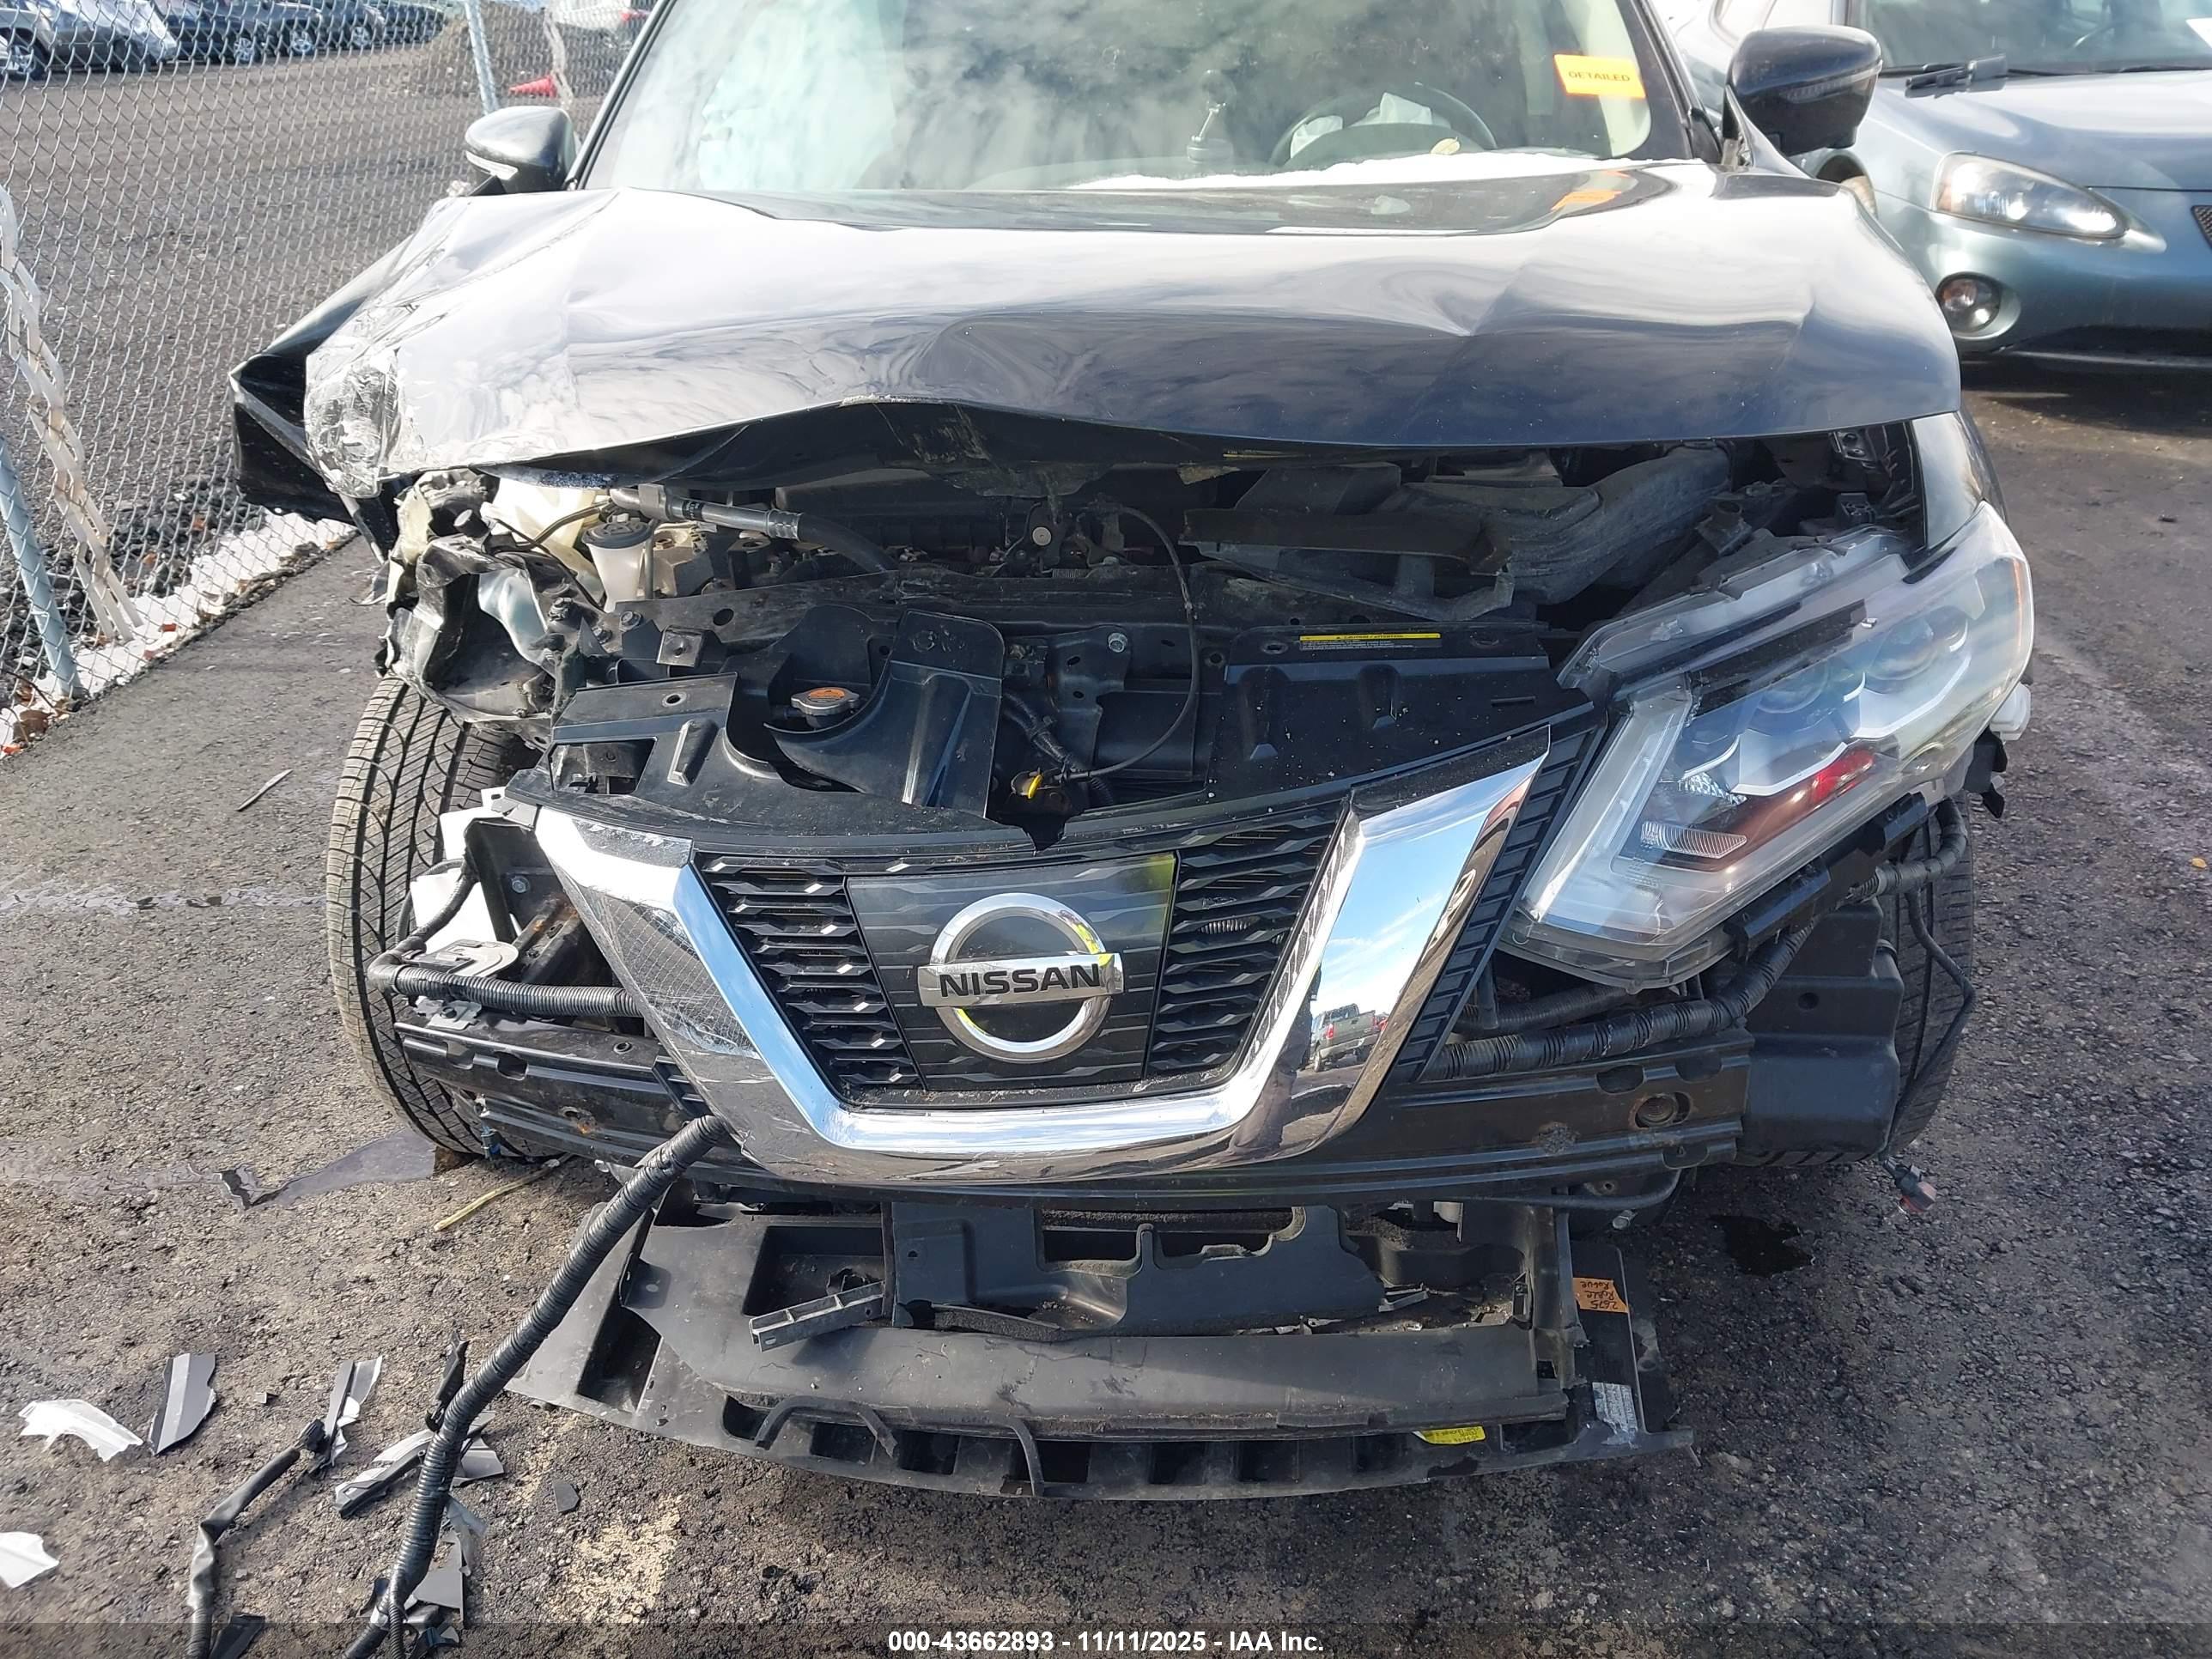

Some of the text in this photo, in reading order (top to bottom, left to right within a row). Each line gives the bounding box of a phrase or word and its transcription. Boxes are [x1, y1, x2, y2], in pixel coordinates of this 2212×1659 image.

[1568, 70, 1631, 82] DETAILED
[939, 963, 1101, 998] NISSAN
[1590, 1300, 1619, 1310] 2675
